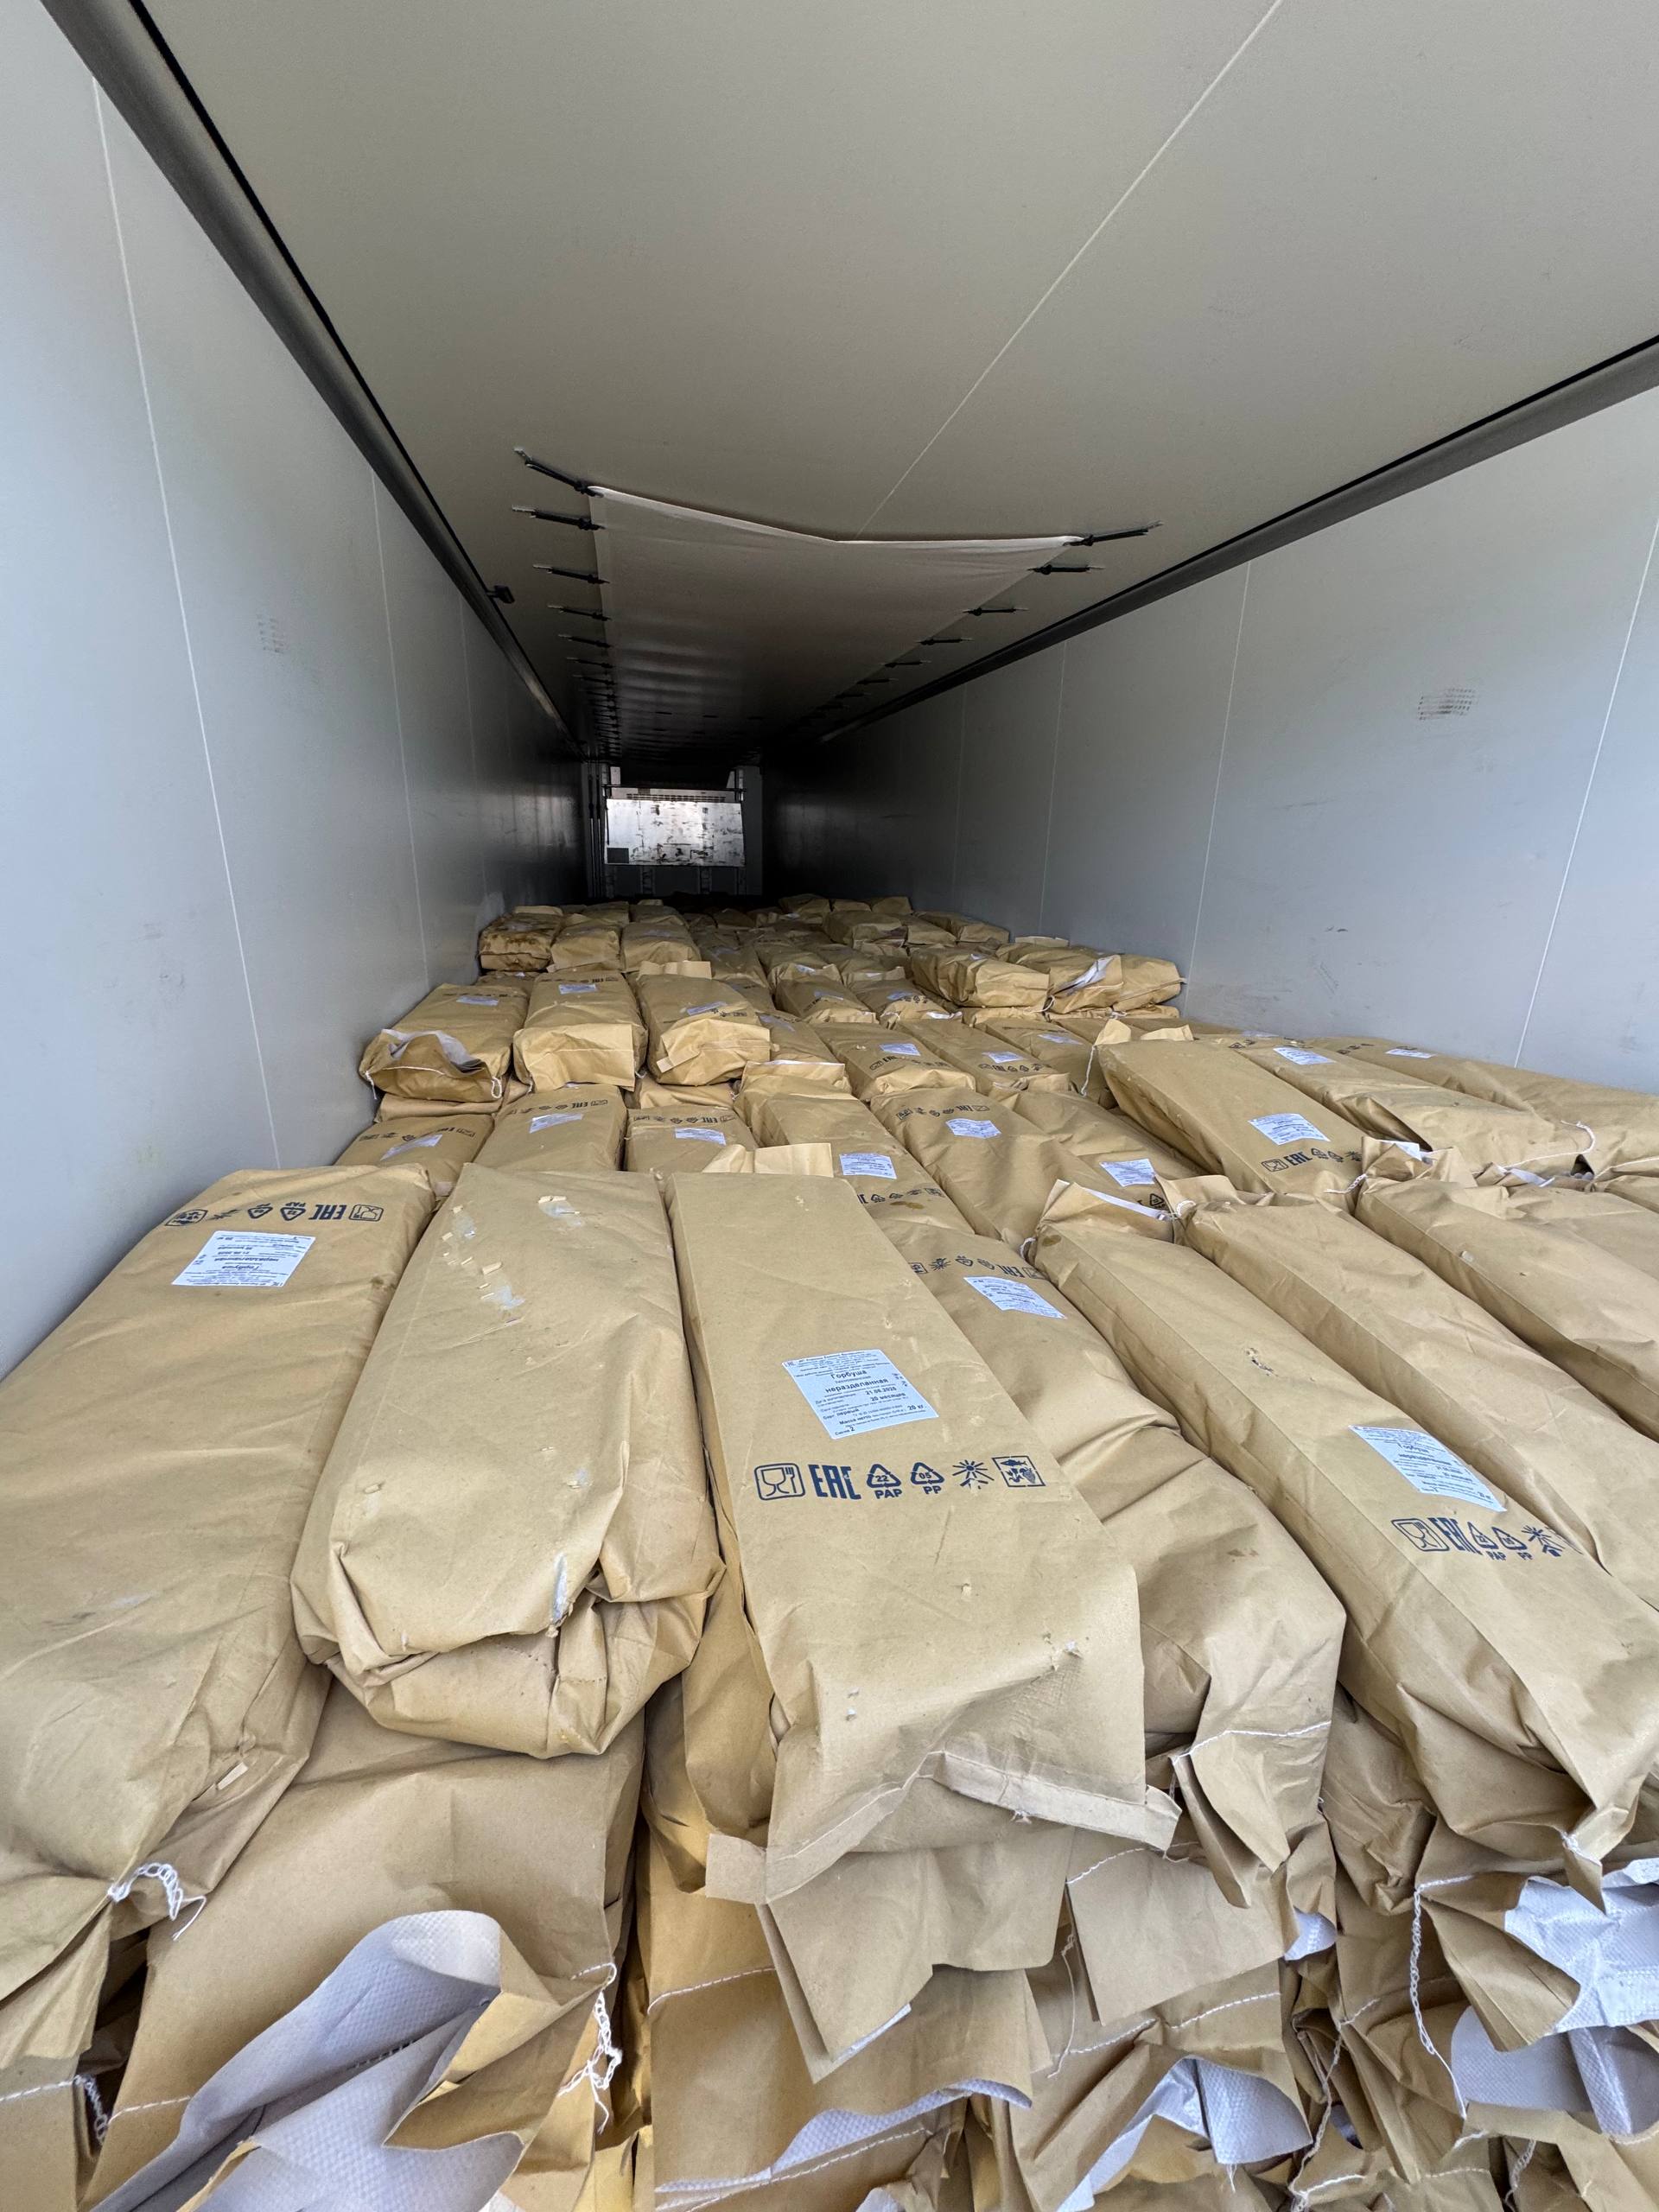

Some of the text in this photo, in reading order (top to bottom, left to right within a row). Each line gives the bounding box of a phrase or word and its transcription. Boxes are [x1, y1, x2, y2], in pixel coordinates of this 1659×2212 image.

[830, 1370, 868, 1379] Горбуша
[808, 1464, 861, 1500] EAC
[874, 1489, 903, 1499] PAP
[923, 1485, 942, 1494] PP
